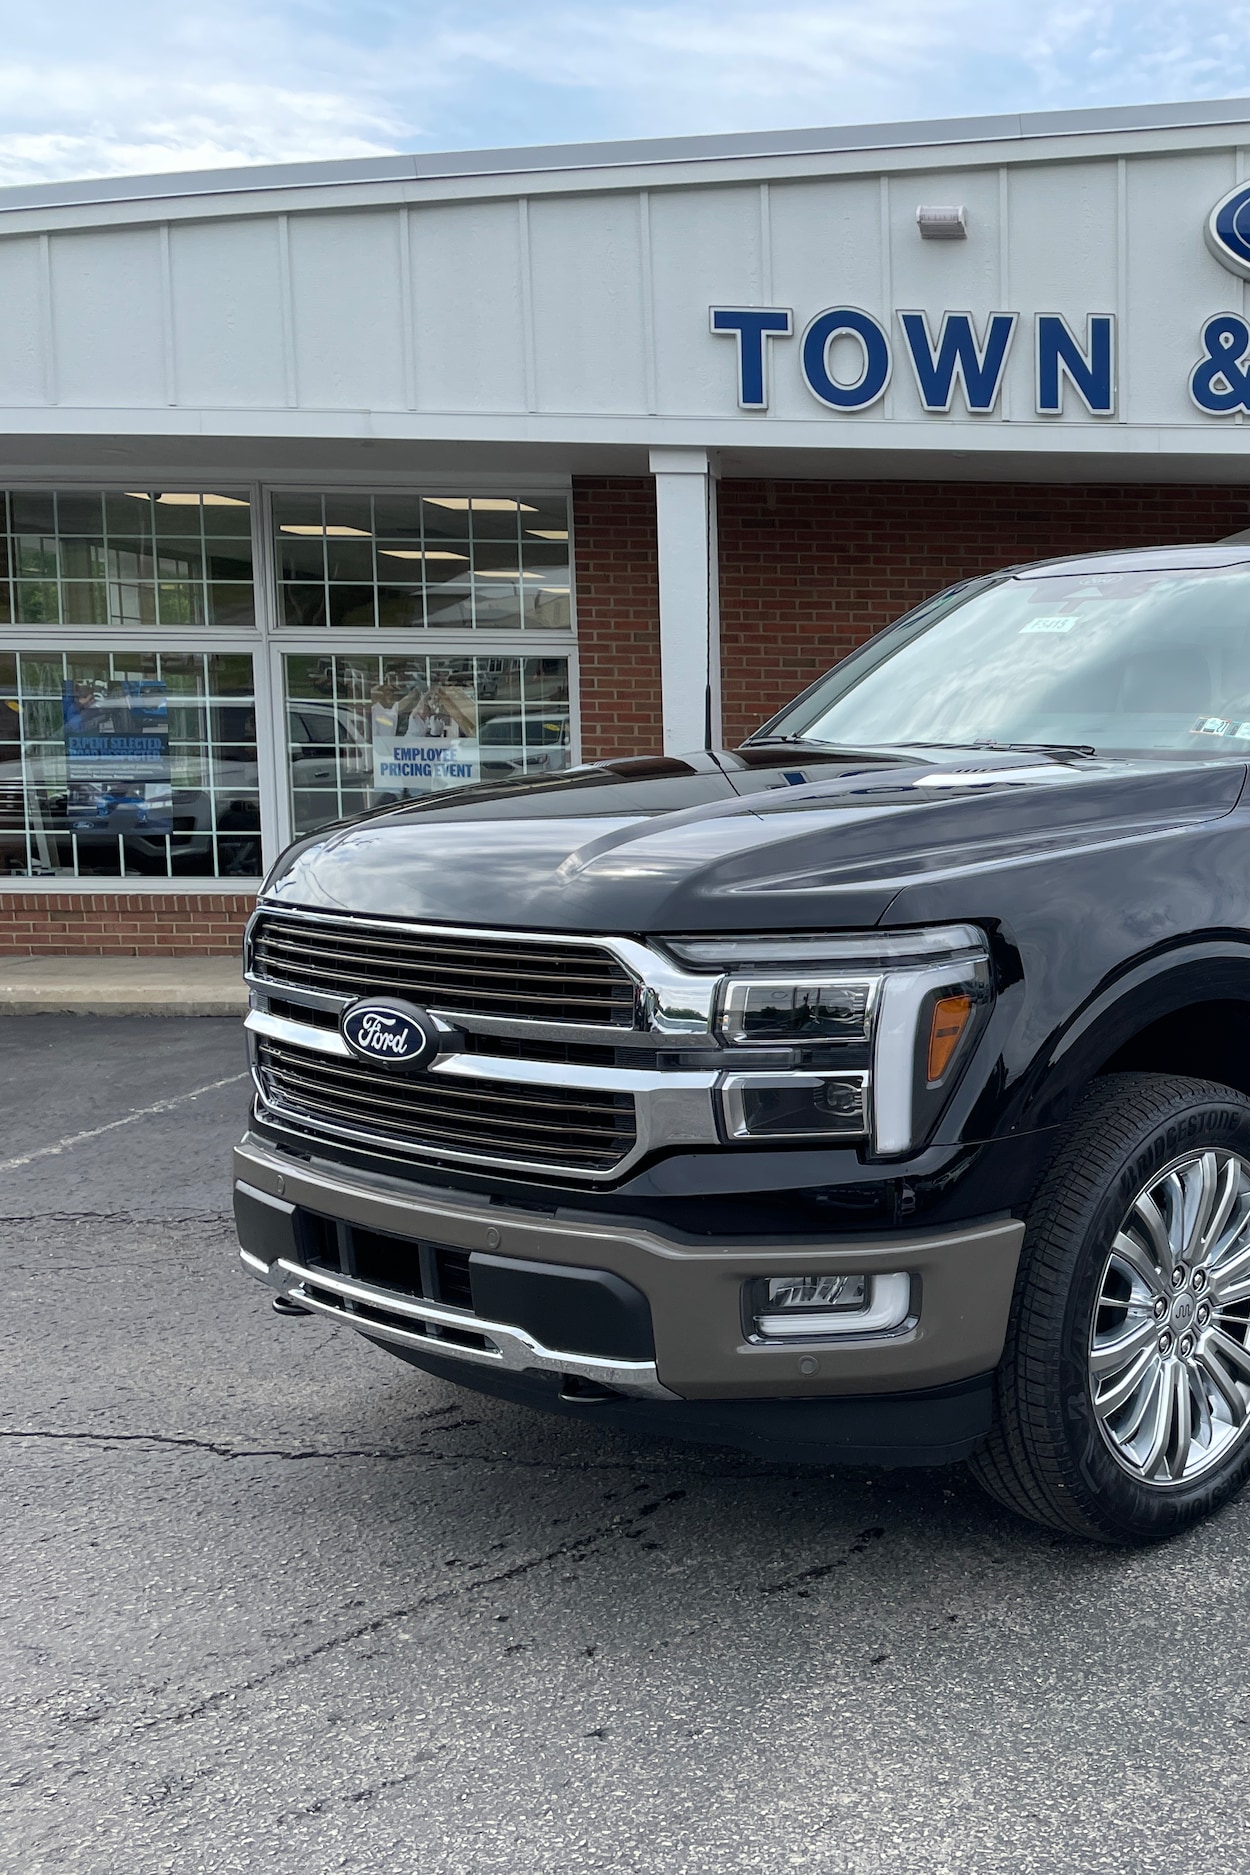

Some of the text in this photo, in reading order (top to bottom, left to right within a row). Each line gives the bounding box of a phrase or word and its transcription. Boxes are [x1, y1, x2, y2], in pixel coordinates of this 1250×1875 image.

[708, 305, 1117, 416] TOWN
[69, 736, 108, 749] EXPERT
[393, 747, 457, 762] EMPLOYEE
[380, 763, 473, 778] PRICING EVENT
[358, 1013, 408, 1054] Ford
[1119, 1110, 1240, 1198] BRIDGESTONE
